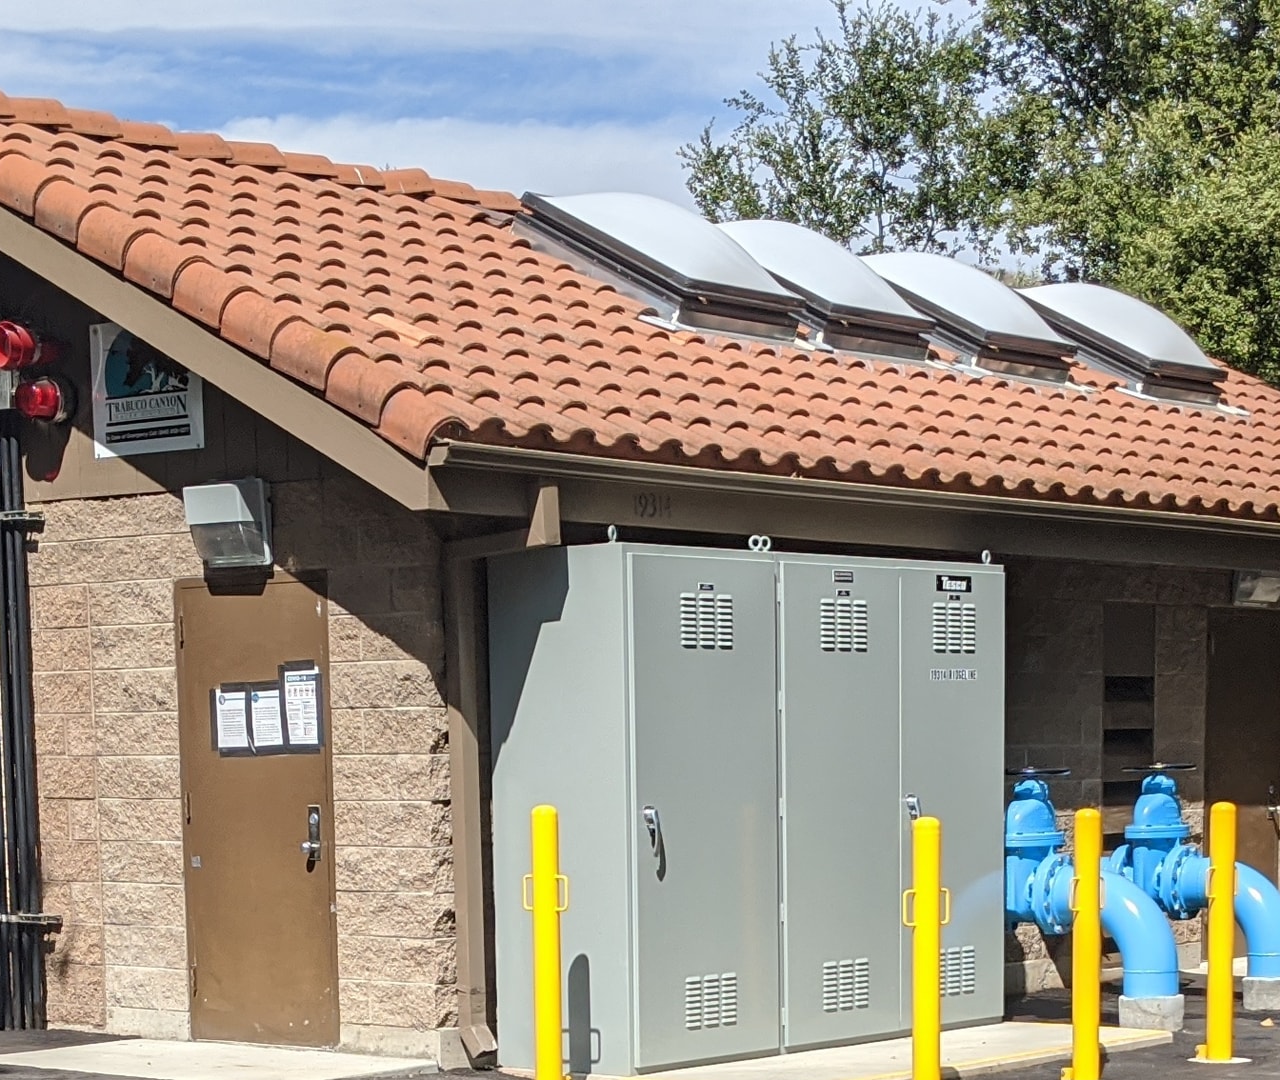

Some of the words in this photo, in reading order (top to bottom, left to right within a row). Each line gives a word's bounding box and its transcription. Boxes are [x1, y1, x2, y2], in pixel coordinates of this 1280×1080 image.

[105, 399, 148, 421] TRABUCO
[149, 394, 187, 414] CANYON
[948, 669, 977, 681] RIDGELINE
